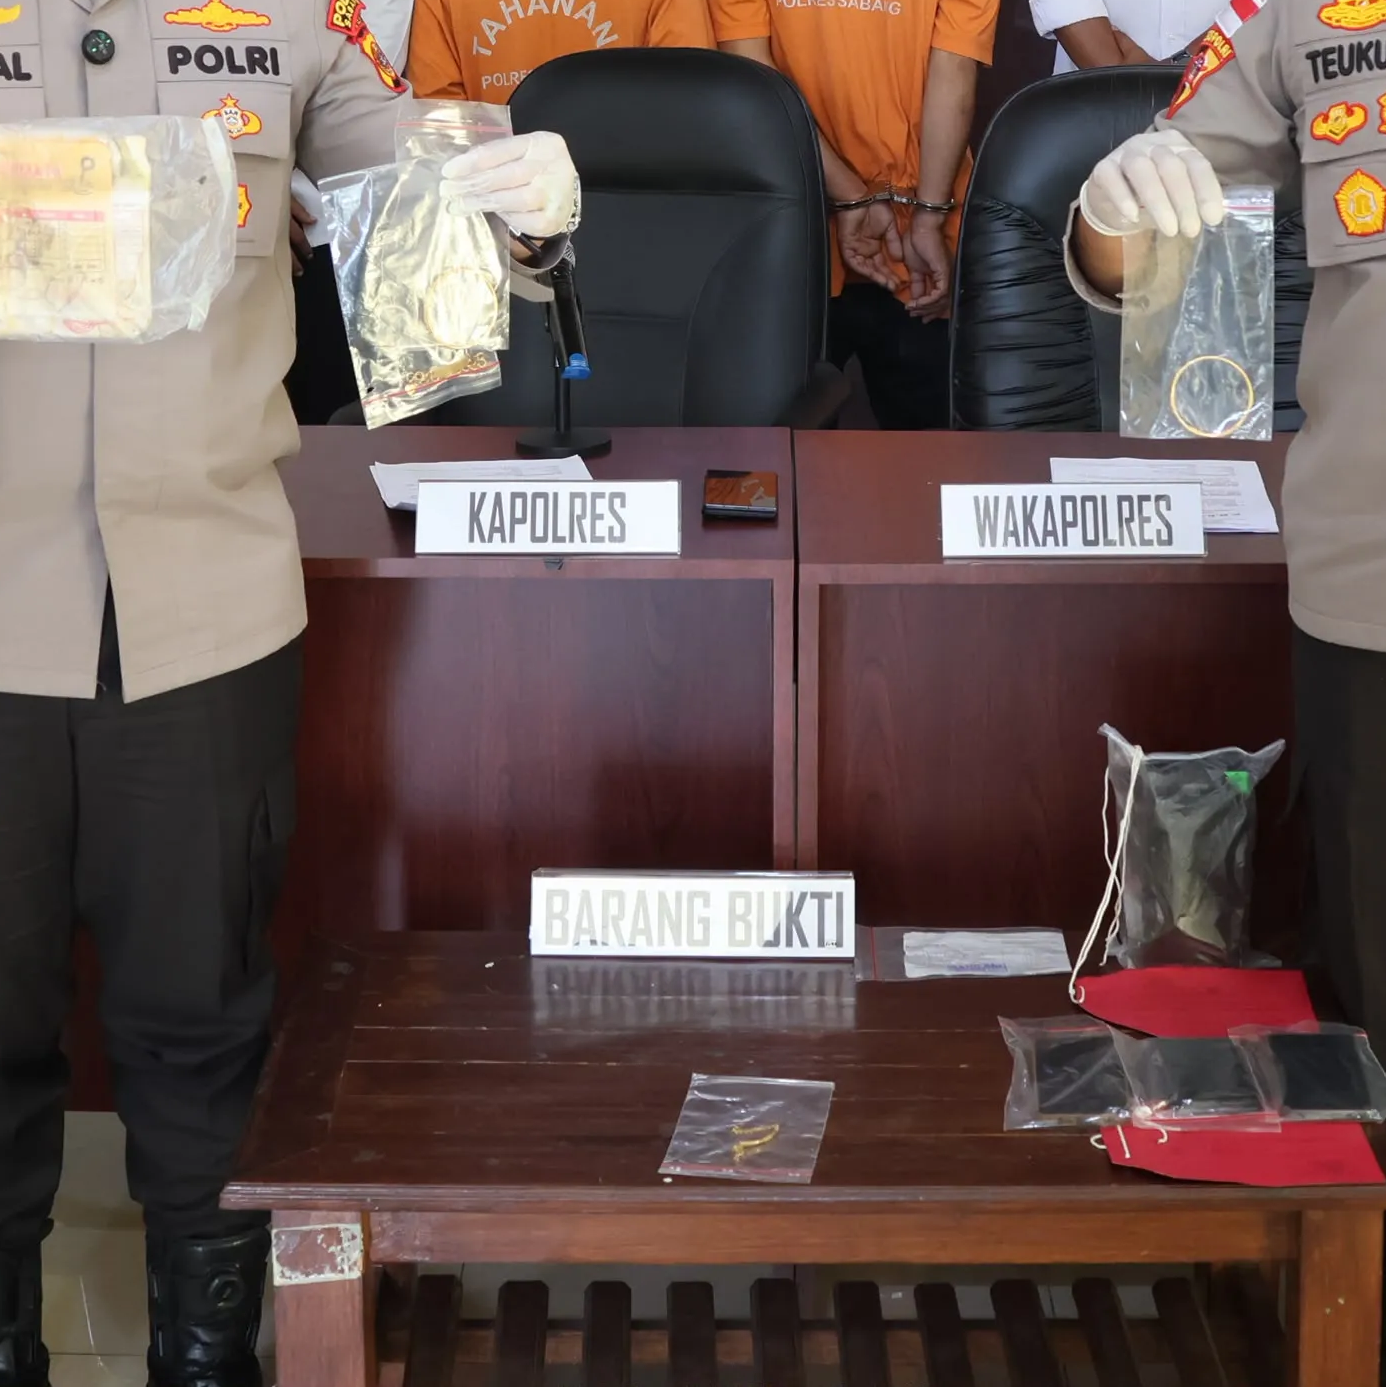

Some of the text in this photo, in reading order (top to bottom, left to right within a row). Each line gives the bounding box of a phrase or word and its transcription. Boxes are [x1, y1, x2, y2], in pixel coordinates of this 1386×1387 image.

[167, 44, 281, 77] POLRI
[481, 69, 533, 90] POLR
[468, 491, 627, 544] KAPOLRES
[973, 494, 1174, 547] WAKAPOLRES
[545, 888, 844, 949] BARANG BUKTI
